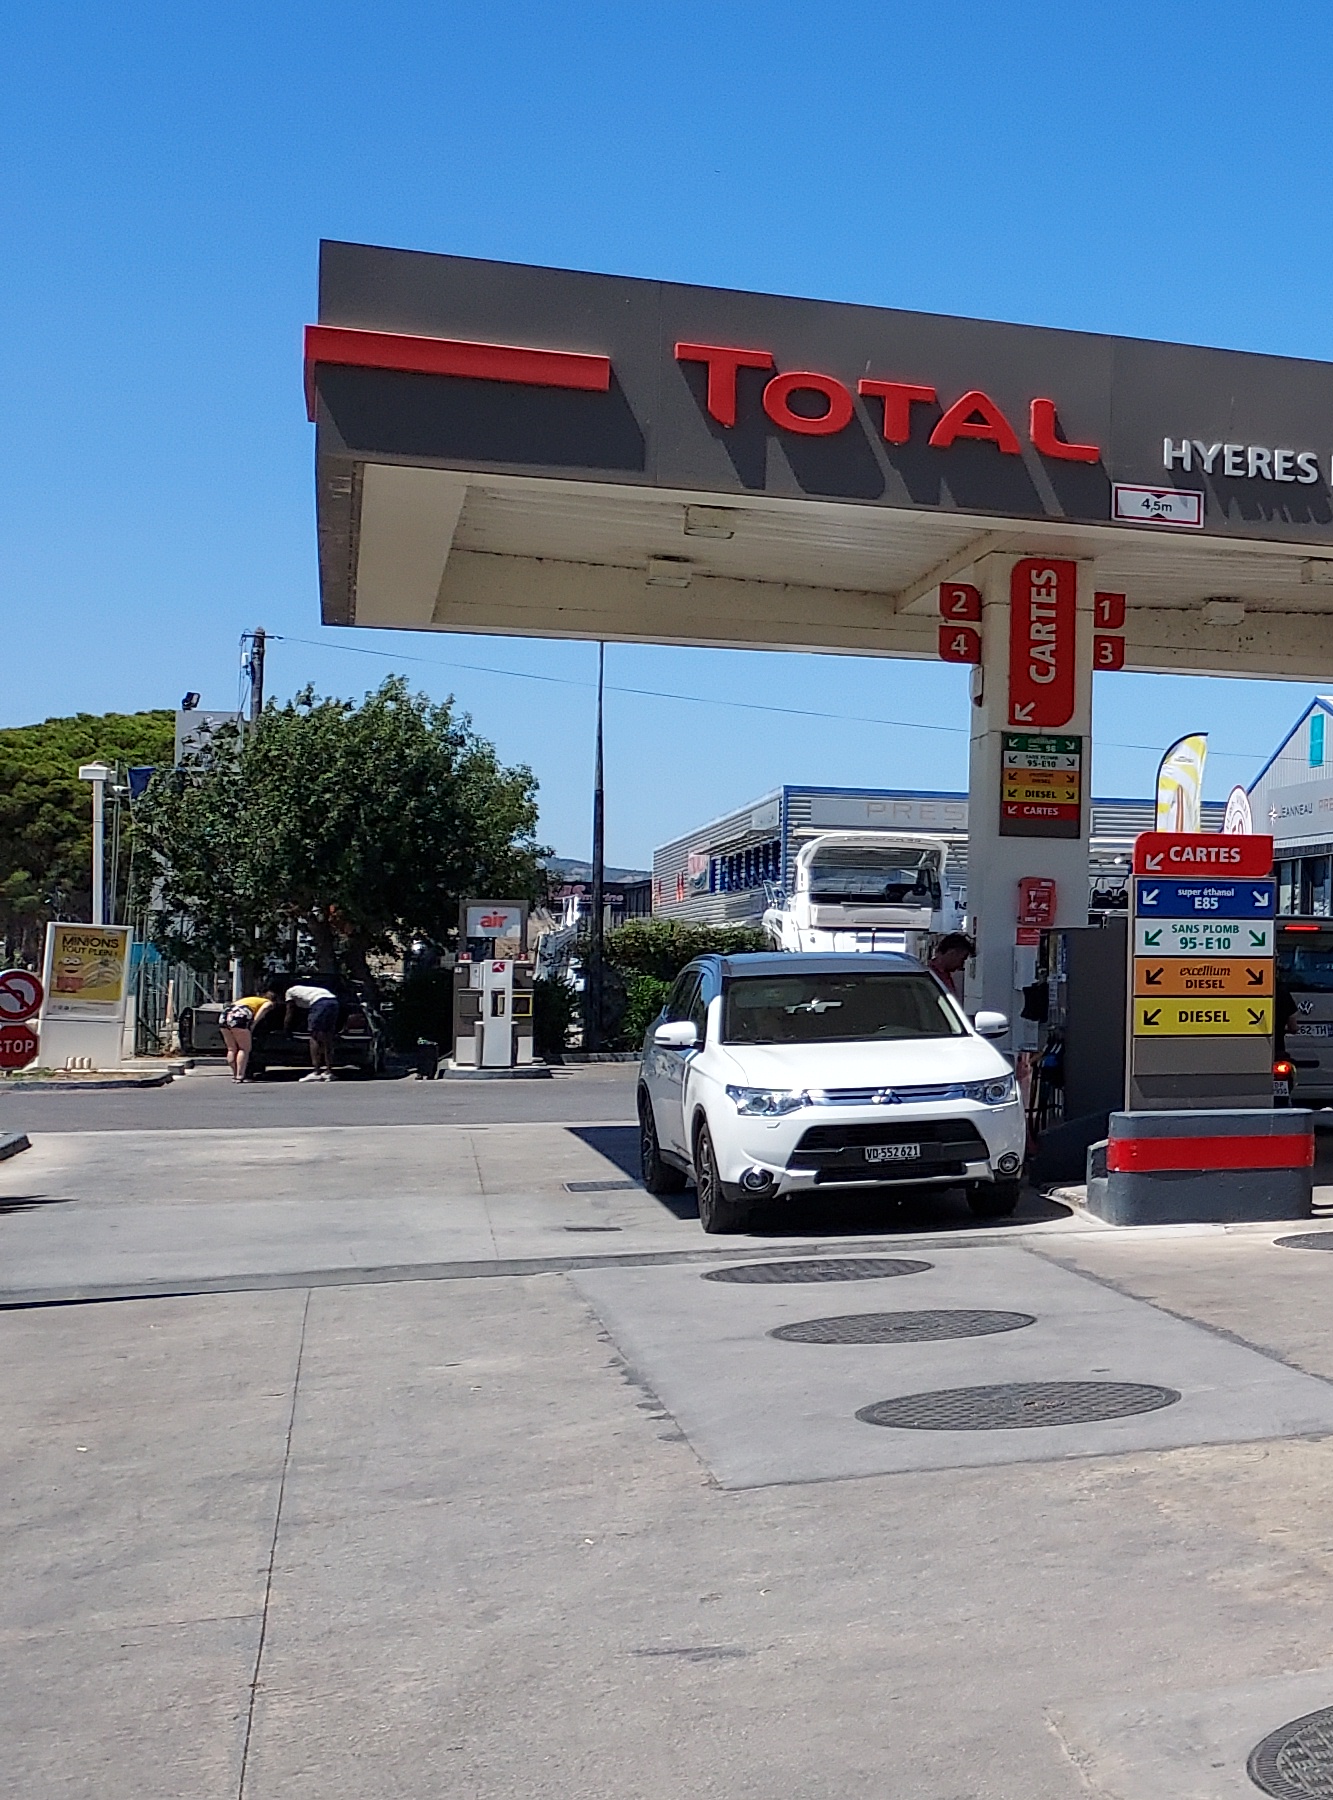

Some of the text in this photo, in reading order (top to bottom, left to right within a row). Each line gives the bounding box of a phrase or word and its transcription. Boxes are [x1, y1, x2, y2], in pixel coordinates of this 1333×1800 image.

[674, 341, 1099, 464] TOTAL
[1163, 437, 1319, 484] HYERES
[951, 591, 968, 612] 2
[1099, 600, 1110, 621] 1
[1029, 569, 1058, 684] CARTES
[951, 634, 968, 655] 4
[1100, 642, 1113, 663] 3
[1025, 790, 1057, 798] DIESEL
[1023, 806, 1059, 815] CARTES
[1169, 846, 1241, 863] CARTES
[1177, 887, 1235, 899] super éthanol
[1194, 897, 1219, 909] E85
[480, 911, 508, 928] air
[1171, 924, 1240, 934] SANS PLOMB
[62, 935, 119, 949] MINIONS
[1179, 937, 1231, 950] 95-E10
[1179, 966, 1231, 976] excellium
[1185, 979, 1225, 989] DIESEL
[1178, 1010, 1230, 1023] DIESEL
